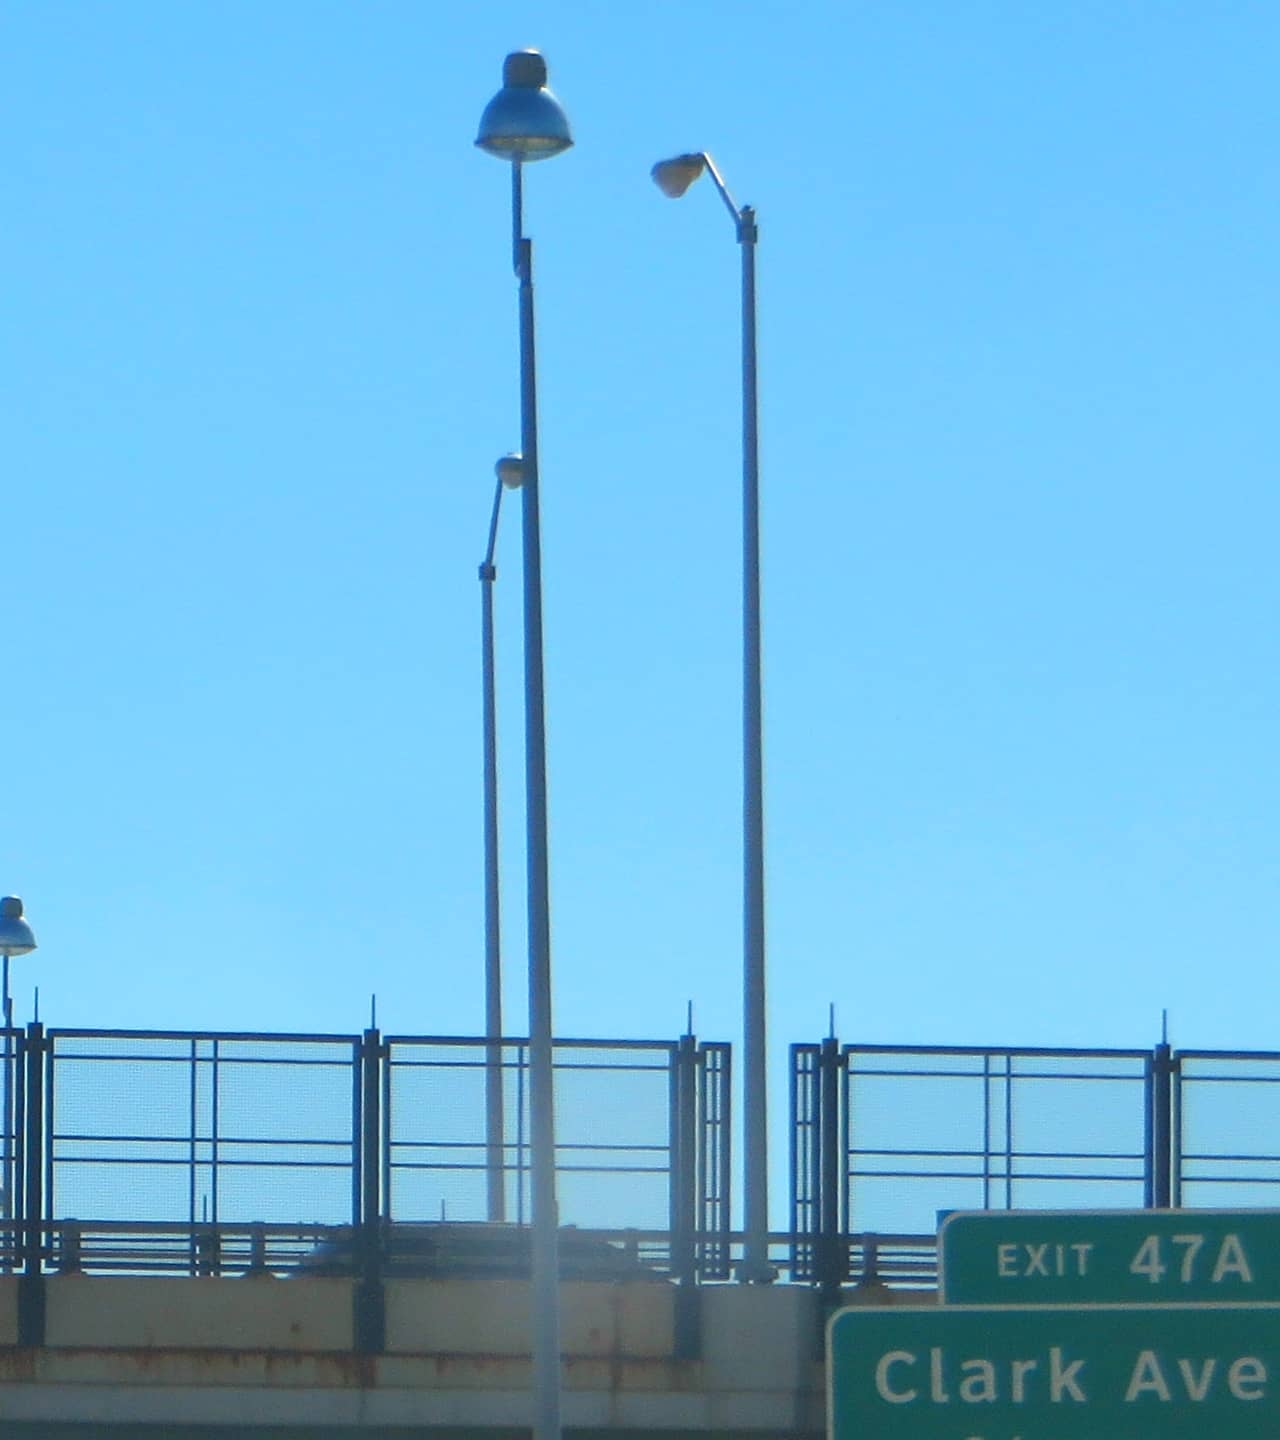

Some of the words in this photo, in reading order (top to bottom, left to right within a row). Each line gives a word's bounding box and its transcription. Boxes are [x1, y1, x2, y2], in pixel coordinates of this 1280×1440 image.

[996, 1243, 1095, 1277] EXIT
[1128, 1233, 1253, 1284] 47A
[874, 1346, 1088, 1404] Clark
[1124, 1349, 1268, 1402] Ave
